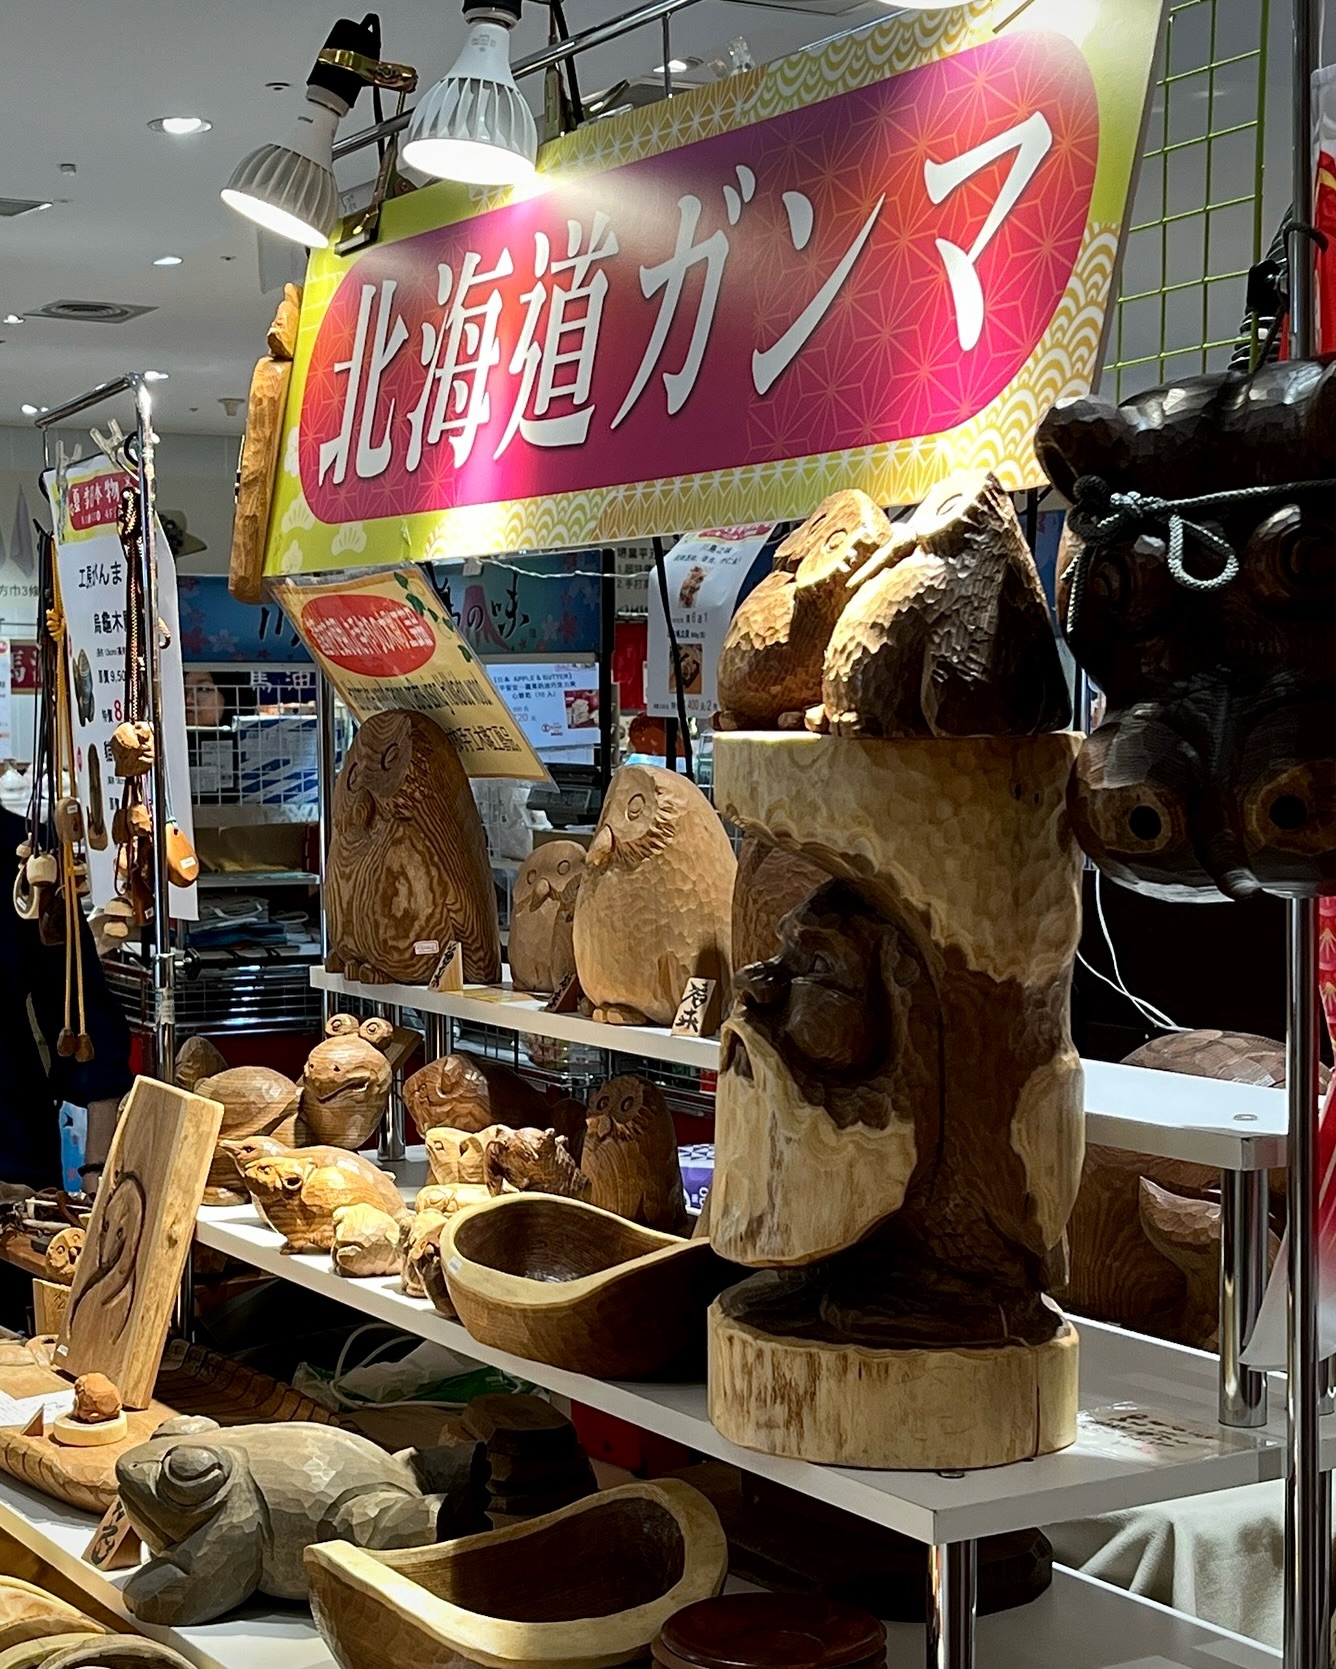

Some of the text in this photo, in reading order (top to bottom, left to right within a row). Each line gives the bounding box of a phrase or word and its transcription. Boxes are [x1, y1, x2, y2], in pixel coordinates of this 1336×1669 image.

[318, 109, 1053, 488] 北海道ガンマ
